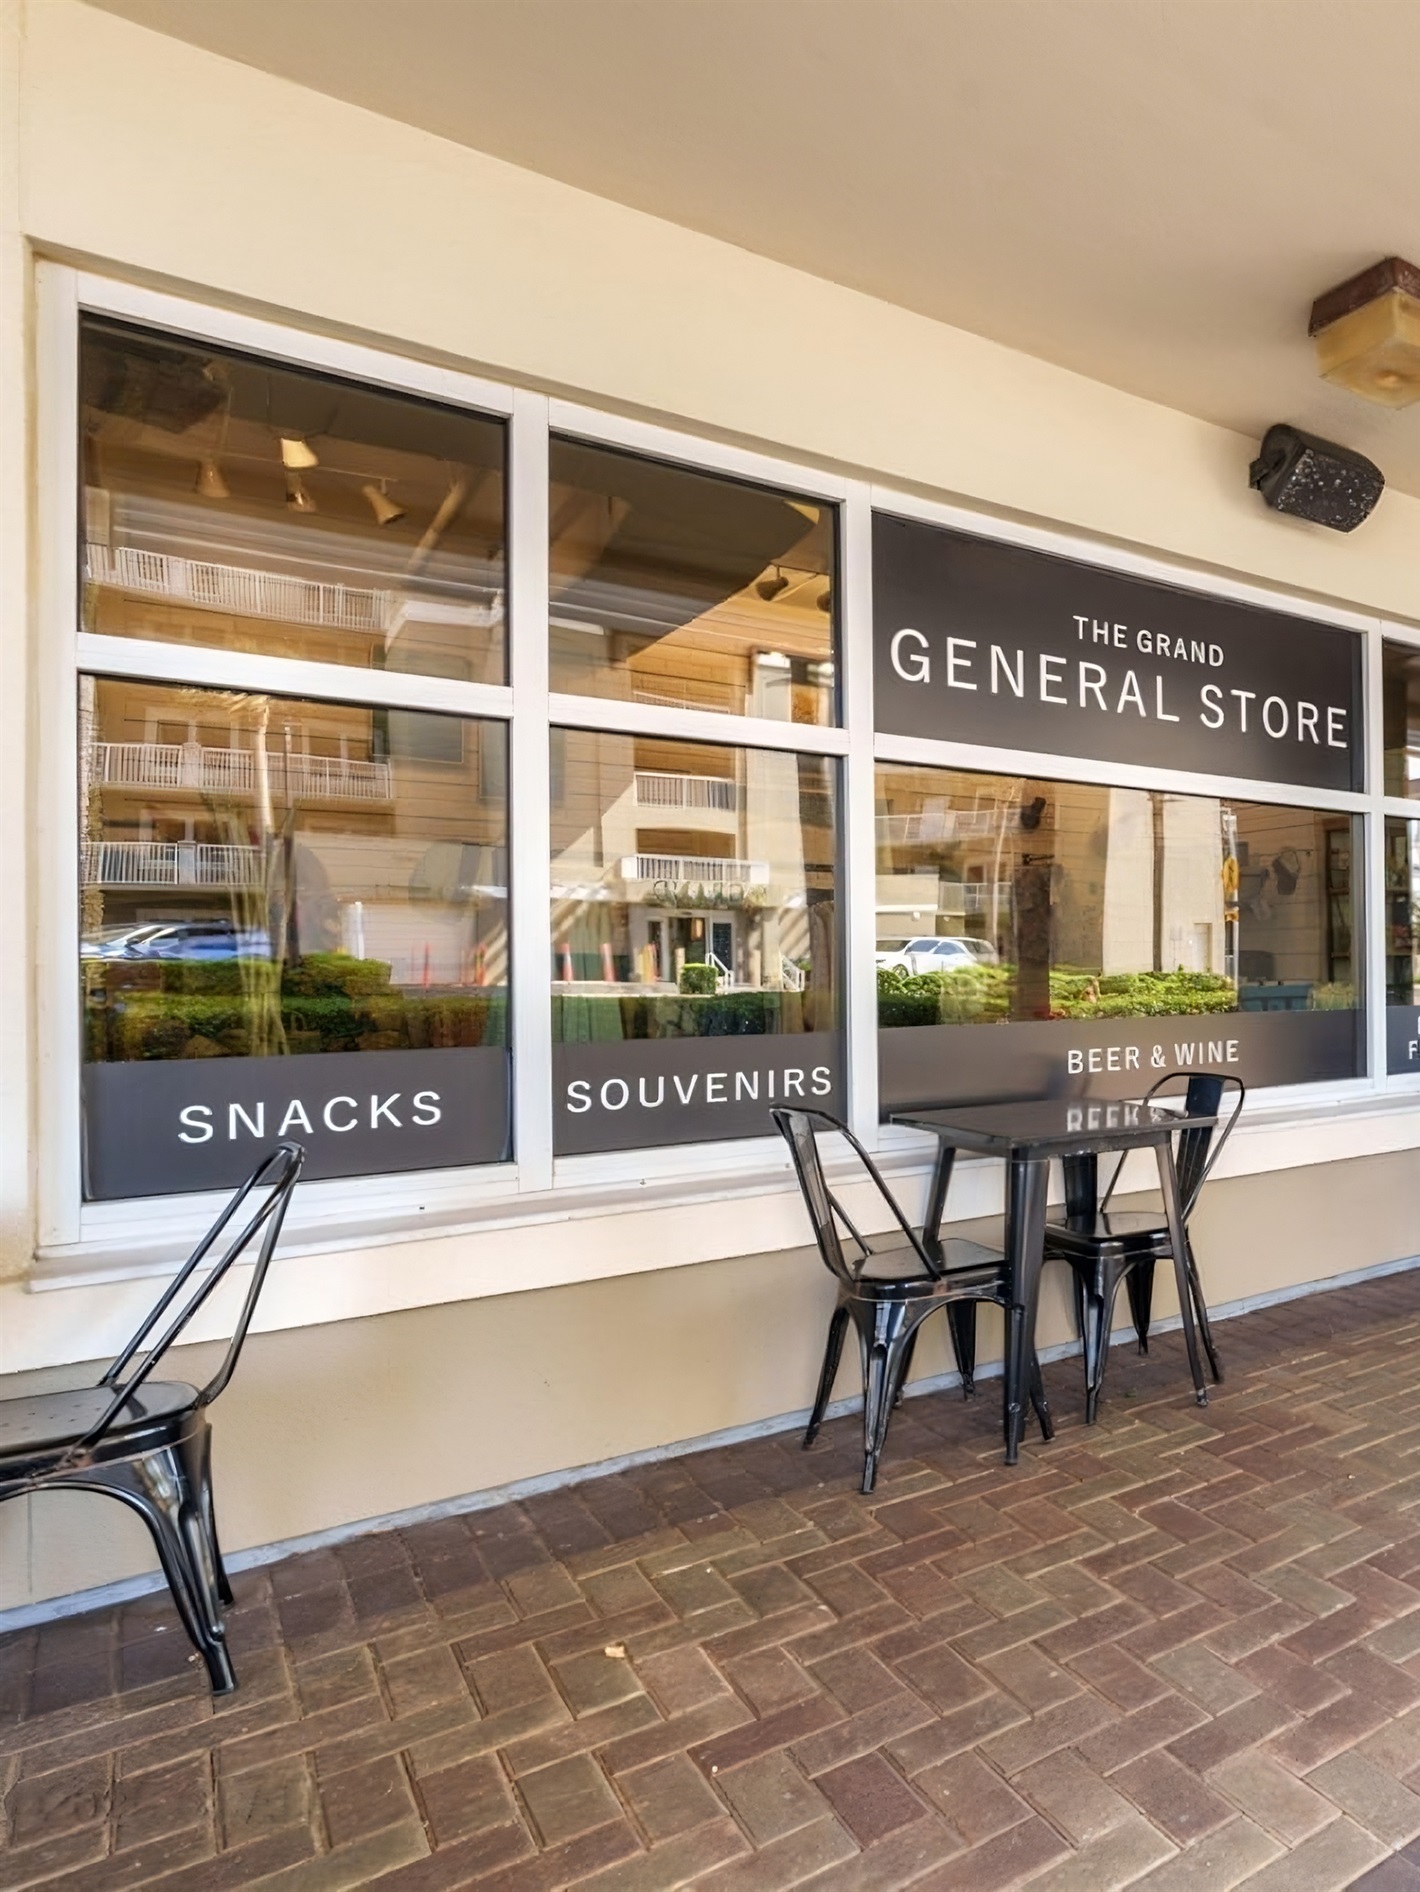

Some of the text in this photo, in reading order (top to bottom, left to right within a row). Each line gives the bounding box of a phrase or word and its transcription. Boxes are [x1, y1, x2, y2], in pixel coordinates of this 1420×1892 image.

[1073, 615, 1224, 667] THE GRAND
[890, 628, 1347, 748] GENERAL STORE
[1067, 1039, 1240, 1074] BEER & WINE
[566, 1066, 833, 1114] SOUVENIRS
[178, 1090, 444, 1144] SNACKS
